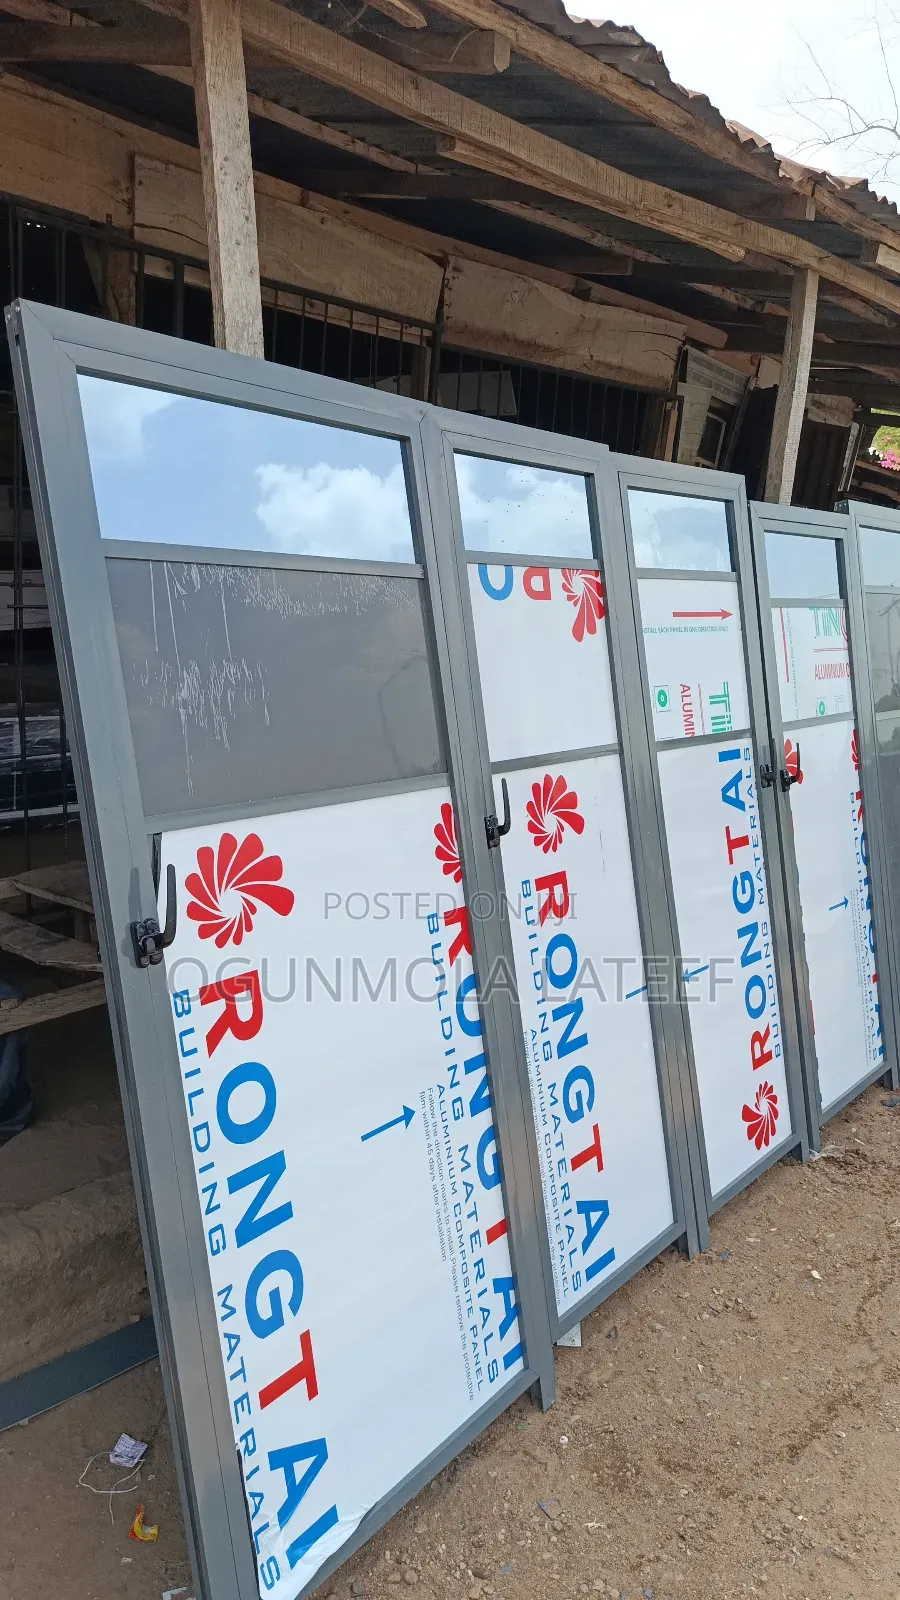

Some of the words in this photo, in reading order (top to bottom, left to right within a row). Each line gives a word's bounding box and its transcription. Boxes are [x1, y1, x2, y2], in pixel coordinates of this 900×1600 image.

[743, 747, 766, 905] MATERIALS
[717, 748, 773, 1071] RONGTAI
[761, 921, 781, 1059] BUILDING
[427, 1087, 436, 1119] Follow
[521, 879, 553, 1062] BUILDING
[547, 1082, 582, 1292] MATERIALS
[534, 870, 616, 1283] RONGTAI
[422, 1111, 431, 1141] within
[426, 912, 464, 1122] BUILDING
[458, 1143, 499, 1384] MATERIALS
[427, 1142, 434, 1156] 45
[428, 1157, 436, 1182] days
[434, 1139, 444, 1181] direction
[530, 1028, 548, 1126] ALUMINIUM
[544, 1132, 562, 1234] COMPOSITE
[557, 1239, 569, 1298] PANEL
[432, 1183, 440, 1206] after
[440, 1183, 449, 1213] marks
[444, 1214, 450, 1225] to
[435, 1208, 447, 1262] installation
[436, 1084, 458, 1196] ALUMINIUM
[453, 1202, 475, 1319] COMPOSITE
[469, 1324, 485, 1392] PANEL
[172, 988, 227, 1257] BUILDING
[216, 1283, 281, 1591] MATERIALS
[199, 969, 339, 1570] RONGTAI
[455, 1294, 464, 1332] remove
[462, 1352, 474, 1401] protective
